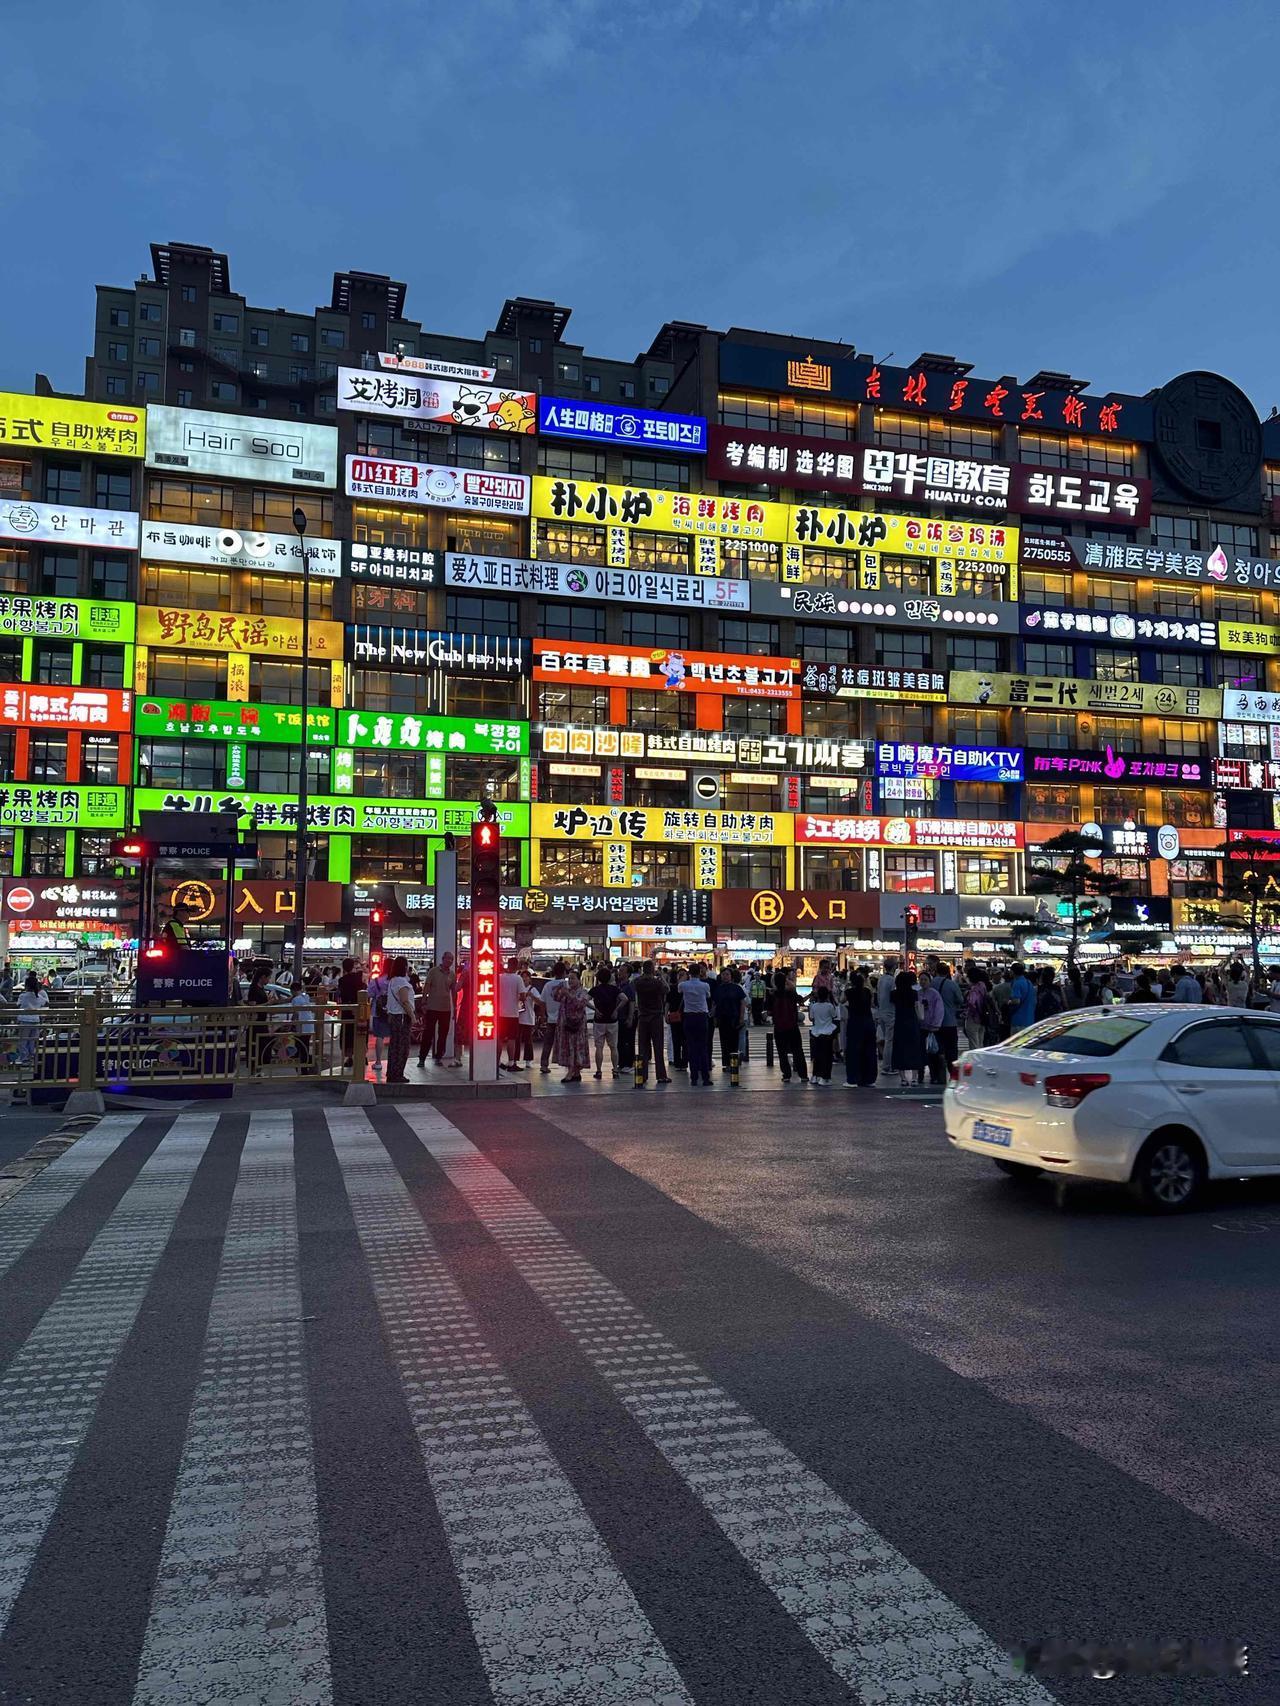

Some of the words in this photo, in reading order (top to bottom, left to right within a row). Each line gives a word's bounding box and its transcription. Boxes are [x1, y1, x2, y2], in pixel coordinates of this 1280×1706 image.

[51, 421, 138, 445] 自助烤肉
[188, 430, 241, 450] Hair
[251, 436, 300, 459] Soo
[726, 440, 789, 473] 考编制
[795, 449, 855, 480] 选华图
[354, 464, 414, 486] 小红猪
[465, 473, 523, 498] 빨간돼지
[351, 482, 419, 499] 韩式自助烤肉
[877, 484, 892, 493] 2001
[1027, 472, 1140, 517] 화도교육
[550, 481, 653, 525] 朴小炉
[672, 495, 765, 523] 海鲜烤肉
[51, 515, 125, 537] 안마관
[795, 508, 888, 548] 朴小炉
[369, 546, 435, 566] 亚美利口腔
[786, 546, 801, 579] 海鲜
[1023, 547, 1071, 562] 2750555
[1084, 542, 1203, 577] 清雅医学美容
[350, 561, 367, 573] 5F
[369, 563, 434, 582] 아미리치과
[452, 556, 559, 591] 爱久亚日式料理
[863, 554, 877, 587] 包饭
[939, 560, 953, 593] 参鸡汤
[957, 560, 1006, 575] 2252000
[715, 582, 739, 600] 5F
[793, 590, 837, 614] 民族
[904, 600, 941, 622] 민족
[0, 619, 79, 637] 아향불고기
[357, 642, 386, 656] The
[393, 645, 426, 659] New
[429, 640, 462, 662] Club
[1159, 692, 1172, 702] 24
[489, 738, 521, 752] 구이
[647, 734, 736, 753] 韩式自助烤肉
[953, 750, 1021, 768] 自助KTV
[0, 810, 79, 823] 아향불고기
[362, 816, 438, 830] 소아향불고기
[663, 811, 774, 831] 旋转自助烤肉
[181, 847, 211, 855] POLICE
[608, 843, 626, 885] 韩式烤肉
[700, 846, 716, 886] 韩式烤肉
[234, 887, 297, 914] 入口
[796, 896, 847, 921] 入口
[179, 978, 213, 988] POLICE
[477, 917, 495, 1038] 行人禁止通行
